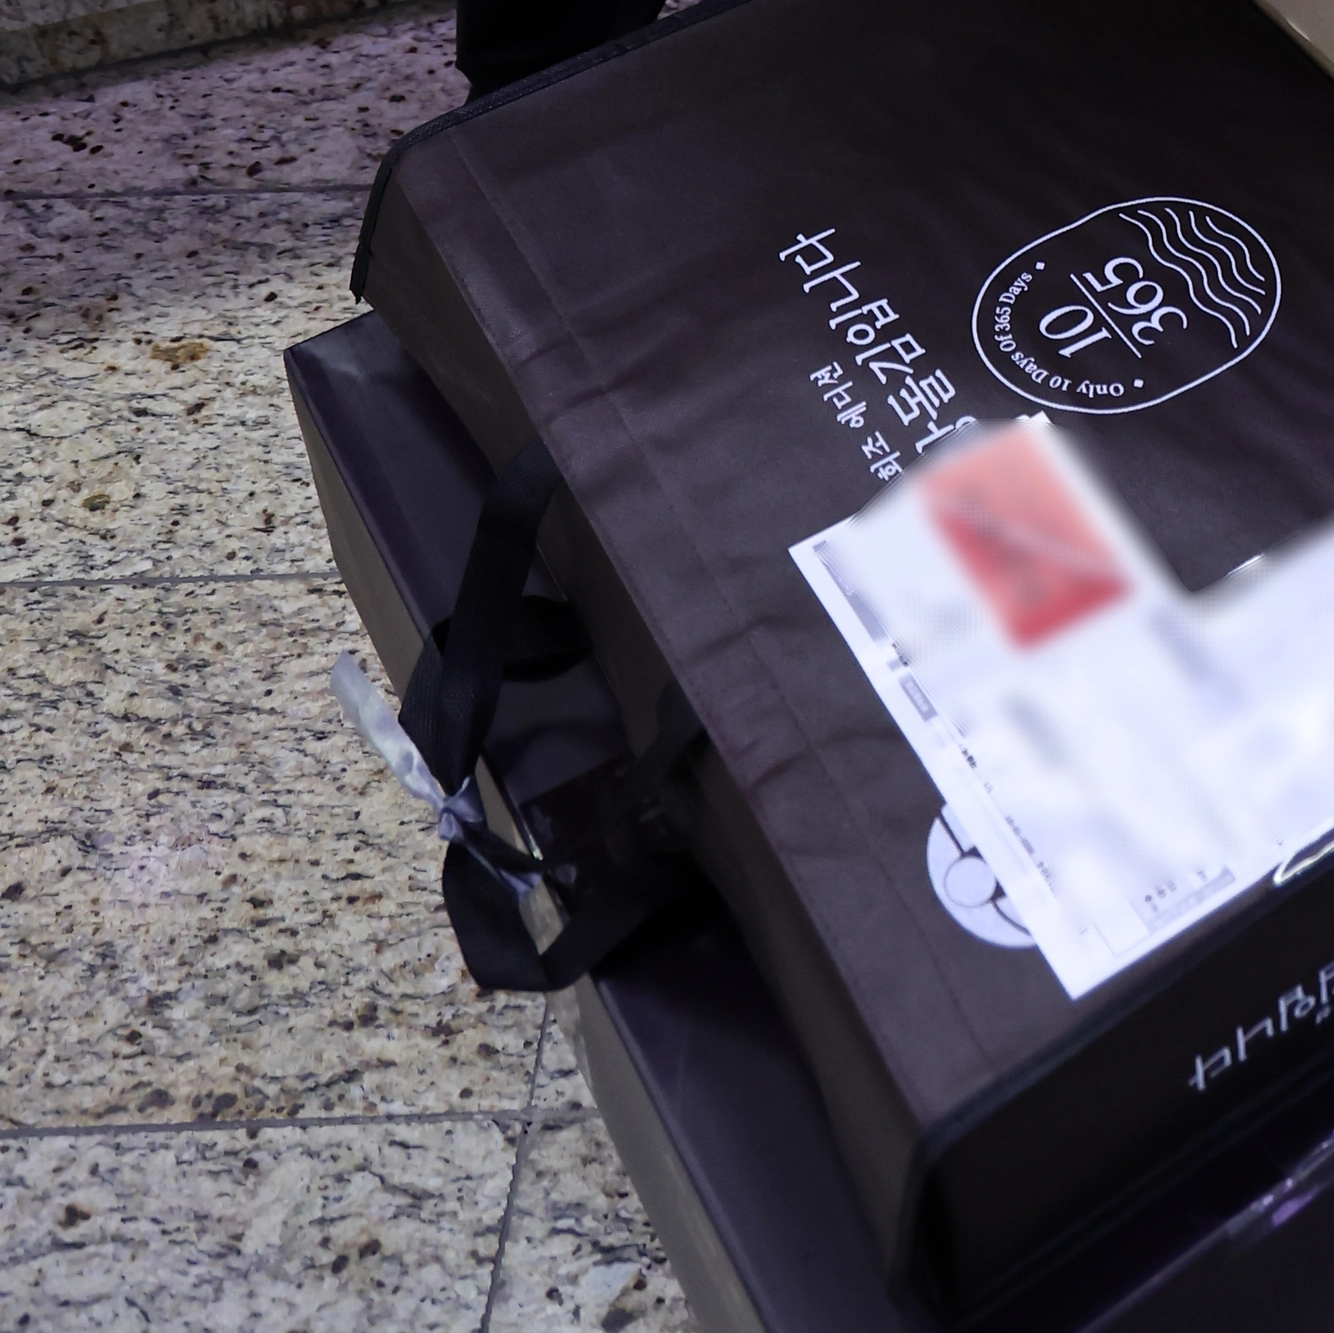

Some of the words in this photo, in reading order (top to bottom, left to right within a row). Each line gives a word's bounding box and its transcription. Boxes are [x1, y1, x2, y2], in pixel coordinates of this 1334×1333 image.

[999, 272, 1033, 305] Days
[1082, 257, 1188, 346] 365
[994, 306, 1012, 332] 365
[1039, 305, 1112, 358] 10
[994, 333, 1016, 352] Of
[1011, 351, 1049, 384] Days
[1049, 376, 1072, 392] 10
[809, 361, 866, 429] 에디션
[1076, 381, 1124, 398] Only
